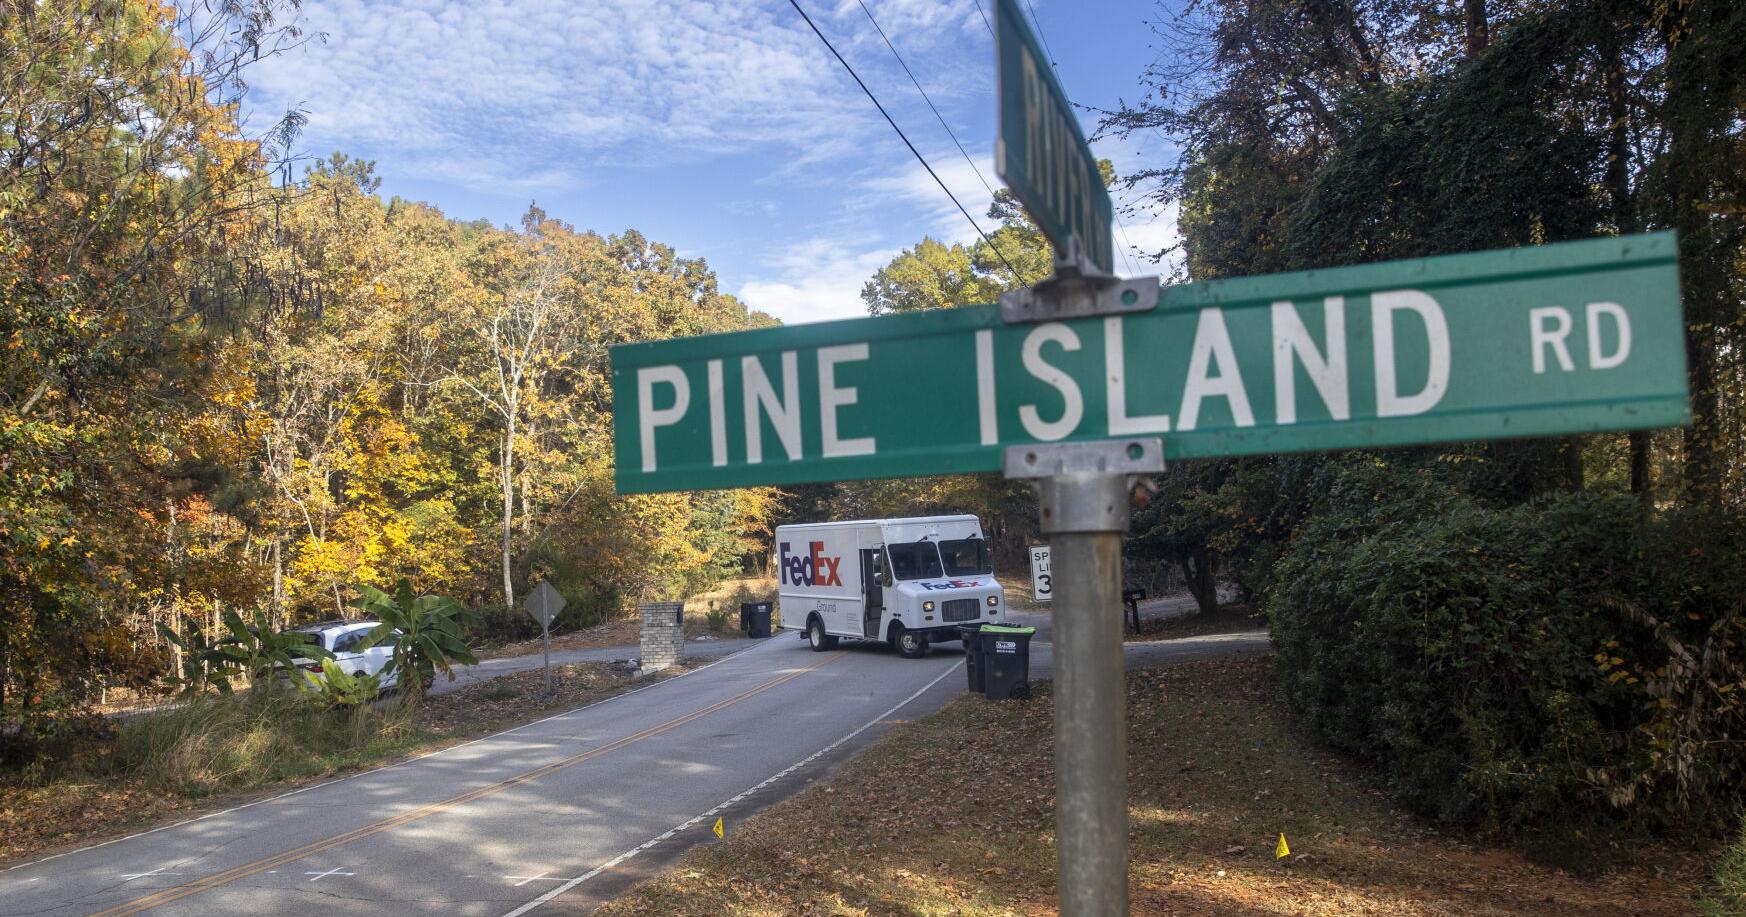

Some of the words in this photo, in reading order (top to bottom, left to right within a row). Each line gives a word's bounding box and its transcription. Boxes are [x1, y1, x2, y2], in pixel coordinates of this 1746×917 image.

[637, 343, 876, 472] PINE
[975, 288, 1451, 446] ISLAND
[1529, 302, 1632, 374] RD
[780, 541, 842, 587] FedEx
[920, 579, 984, 590] FedEx
[817, 600, 836, 613] Ground
